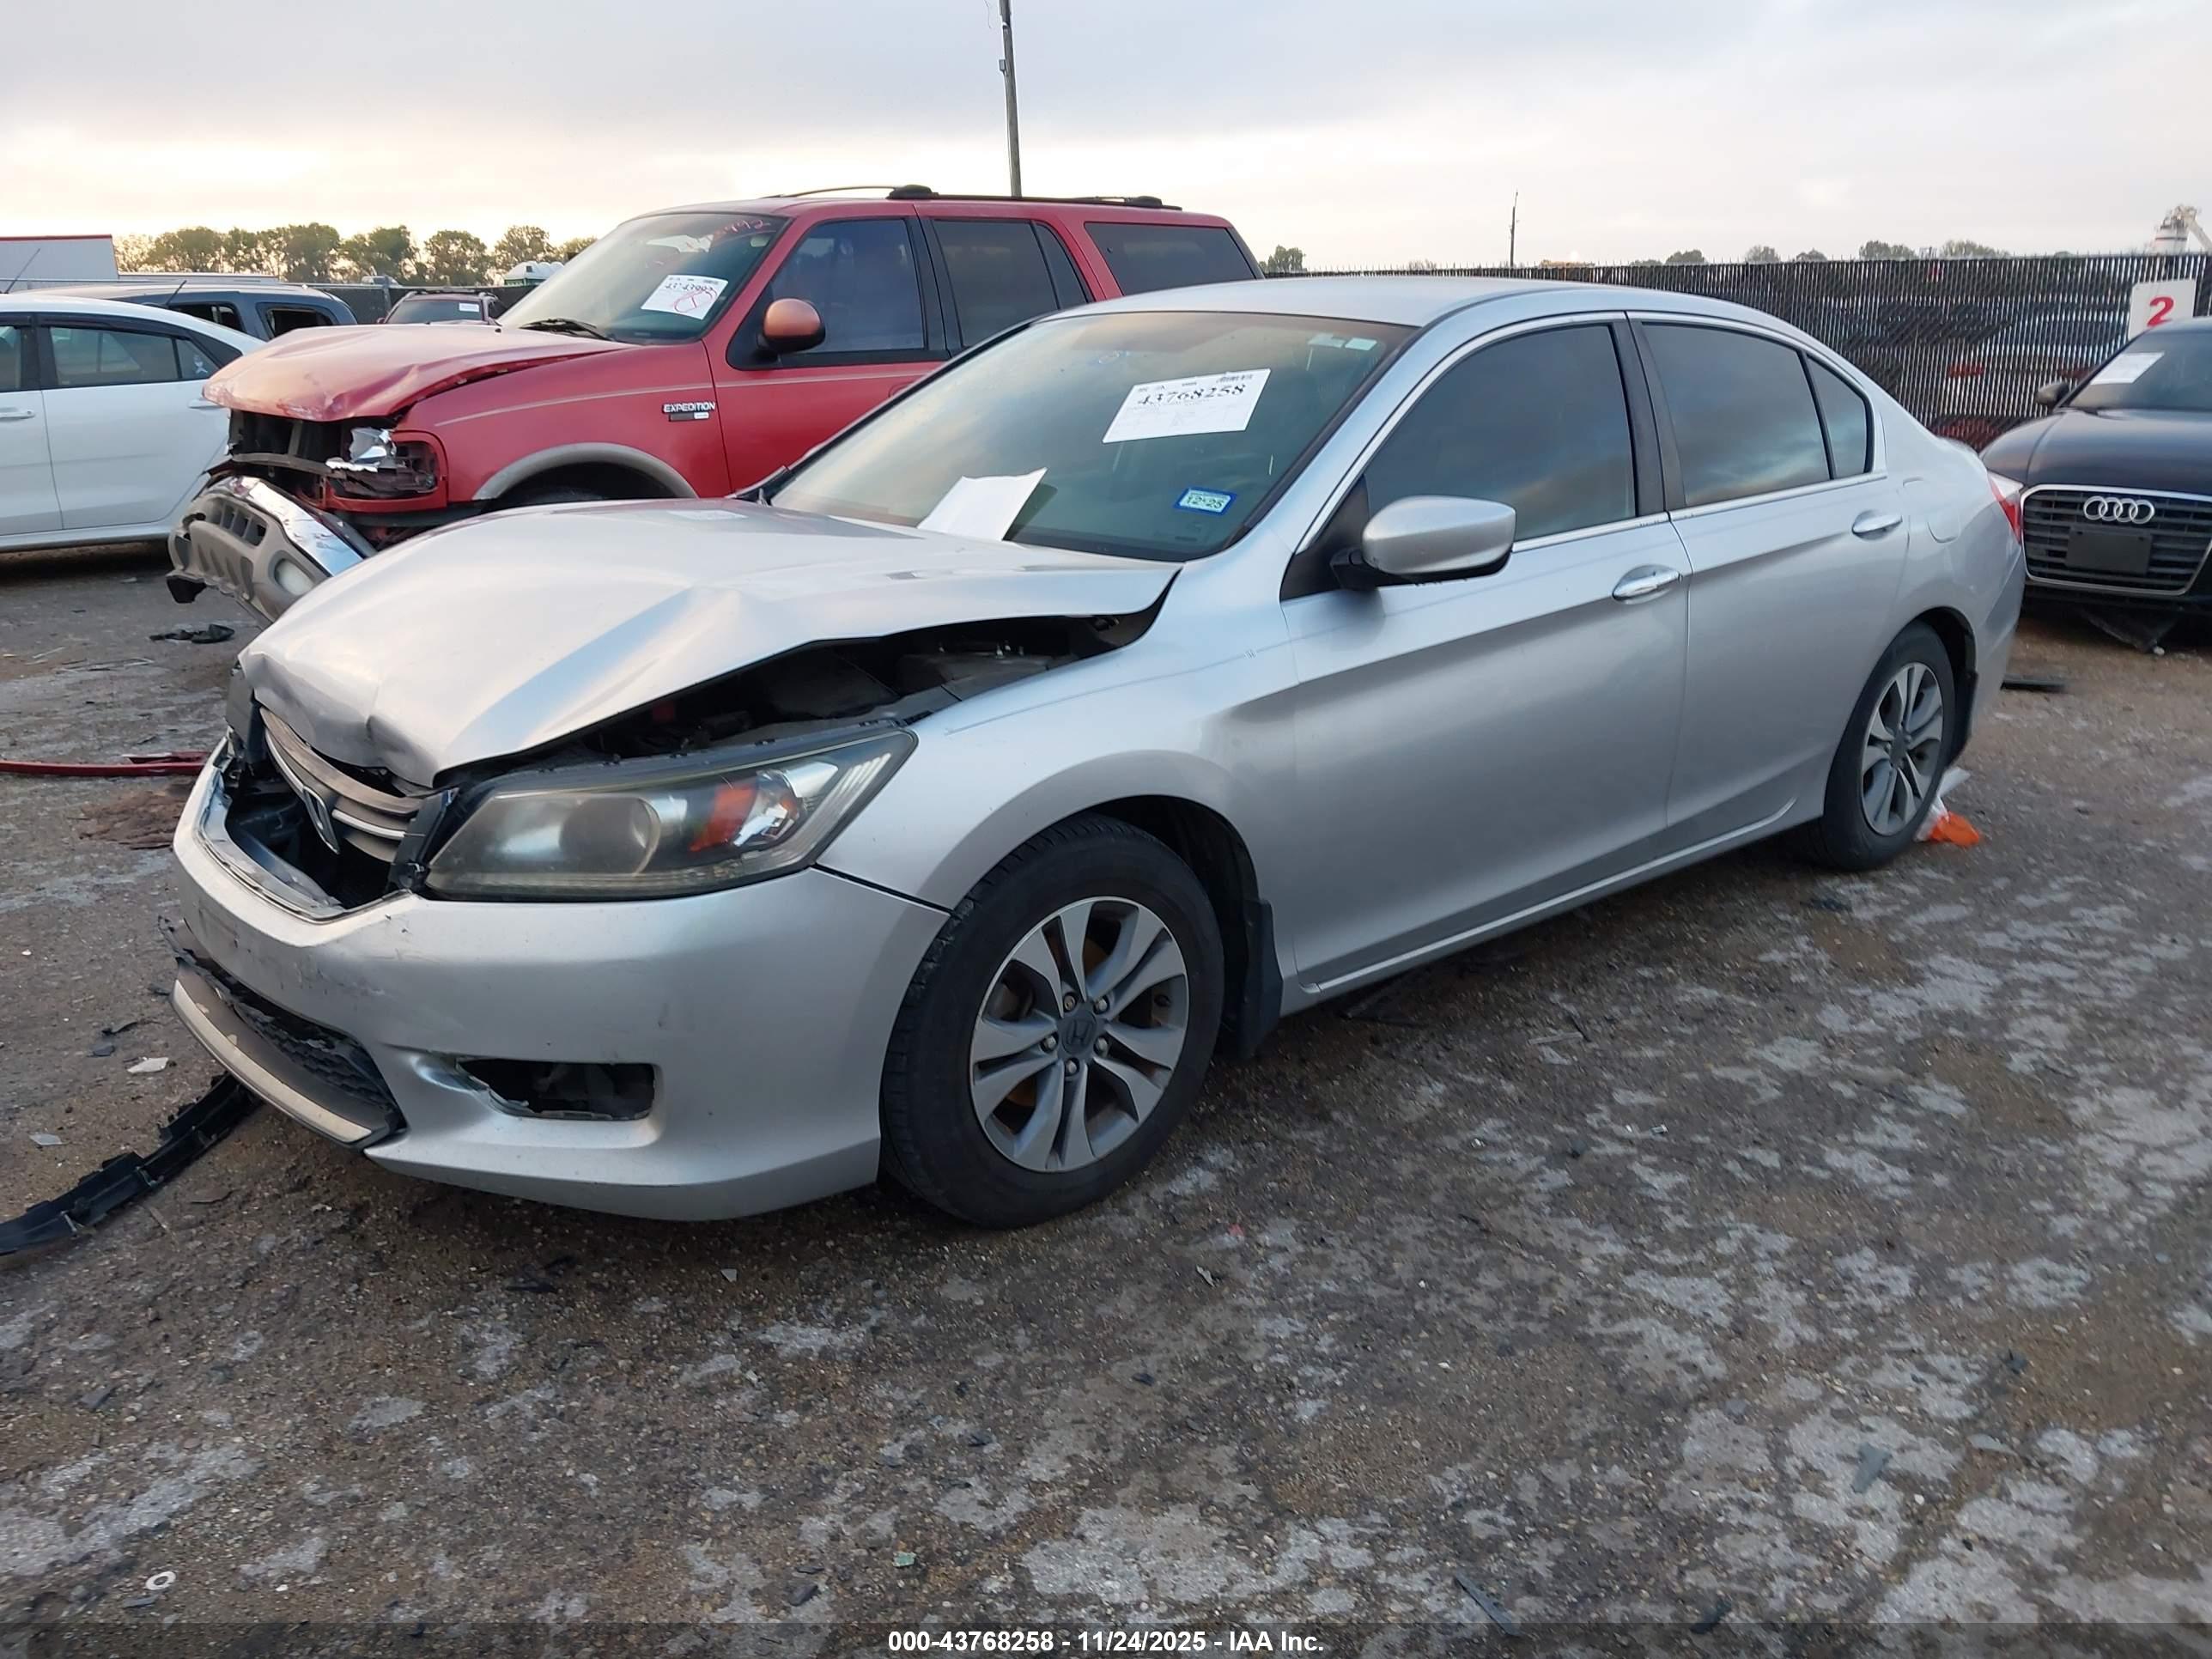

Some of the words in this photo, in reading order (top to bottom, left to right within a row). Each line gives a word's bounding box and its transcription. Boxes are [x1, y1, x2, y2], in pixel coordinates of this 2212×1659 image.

[2147, 295, 2174, 327] 2
[1137, 383, 1246, 405] 43768258
[662, 400, 716, 413] EXPEDITION
